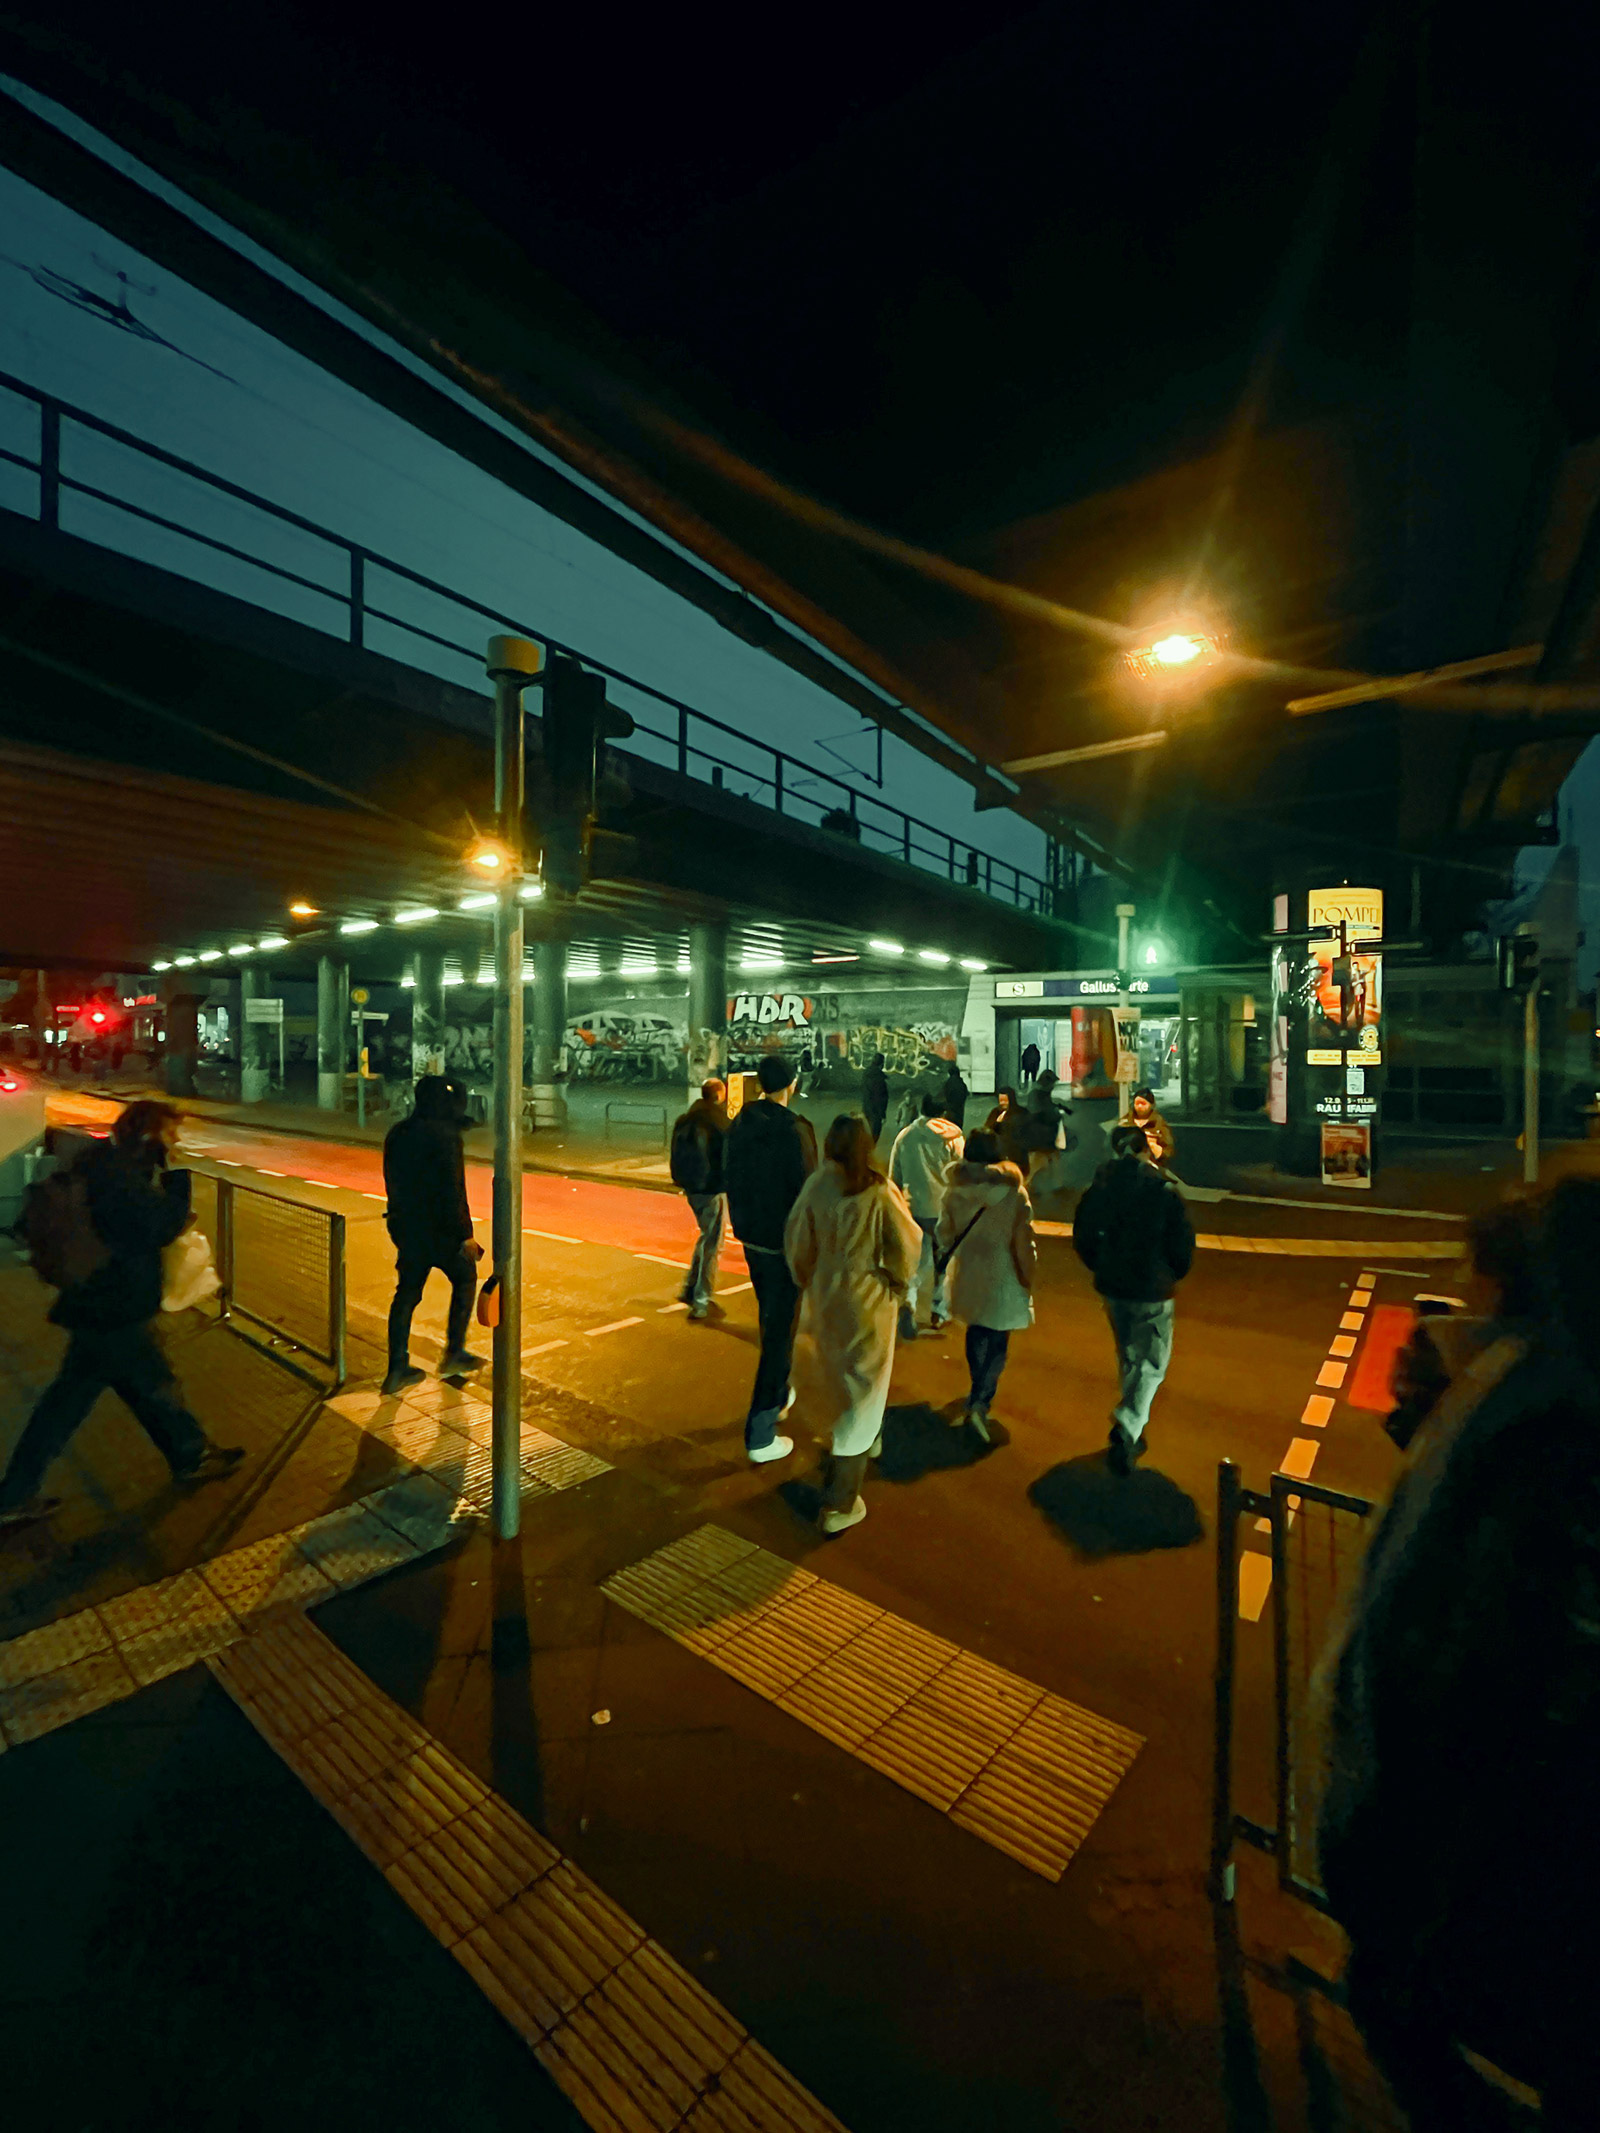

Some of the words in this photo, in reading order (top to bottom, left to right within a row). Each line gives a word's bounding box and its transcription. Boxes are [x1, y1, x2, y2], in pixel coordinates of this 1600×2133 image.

[1013, 982, 1025, 997] S
[1079, 981, 1149, 994] Gallusarte
[732, 993, 810, 1027] HDR
